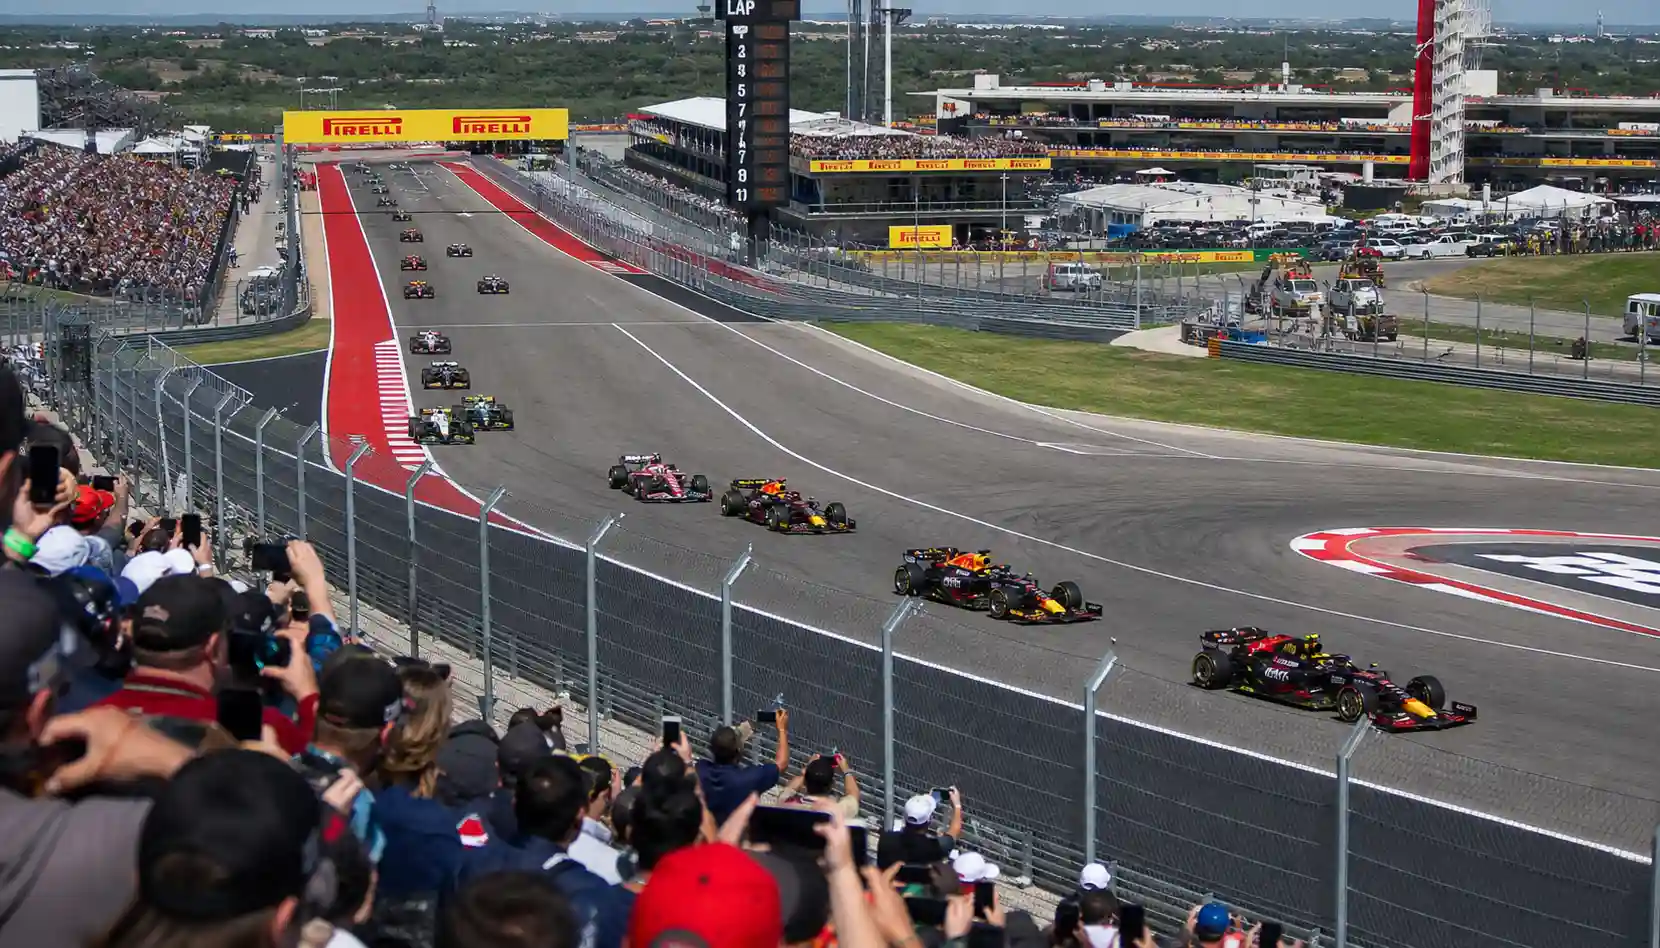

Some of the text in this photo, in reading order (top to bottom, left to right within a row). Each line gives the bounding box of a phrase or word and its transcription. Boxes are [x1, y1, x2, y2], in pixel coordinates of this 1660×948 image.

[727, 0, 755, 15] LAP
[737, 44, 746, 58] 2
[737, 83, 746, 97] 5
[322, 117, 403, 136] PIRELLI
[453, 115, 532, 134] PIRELLI
